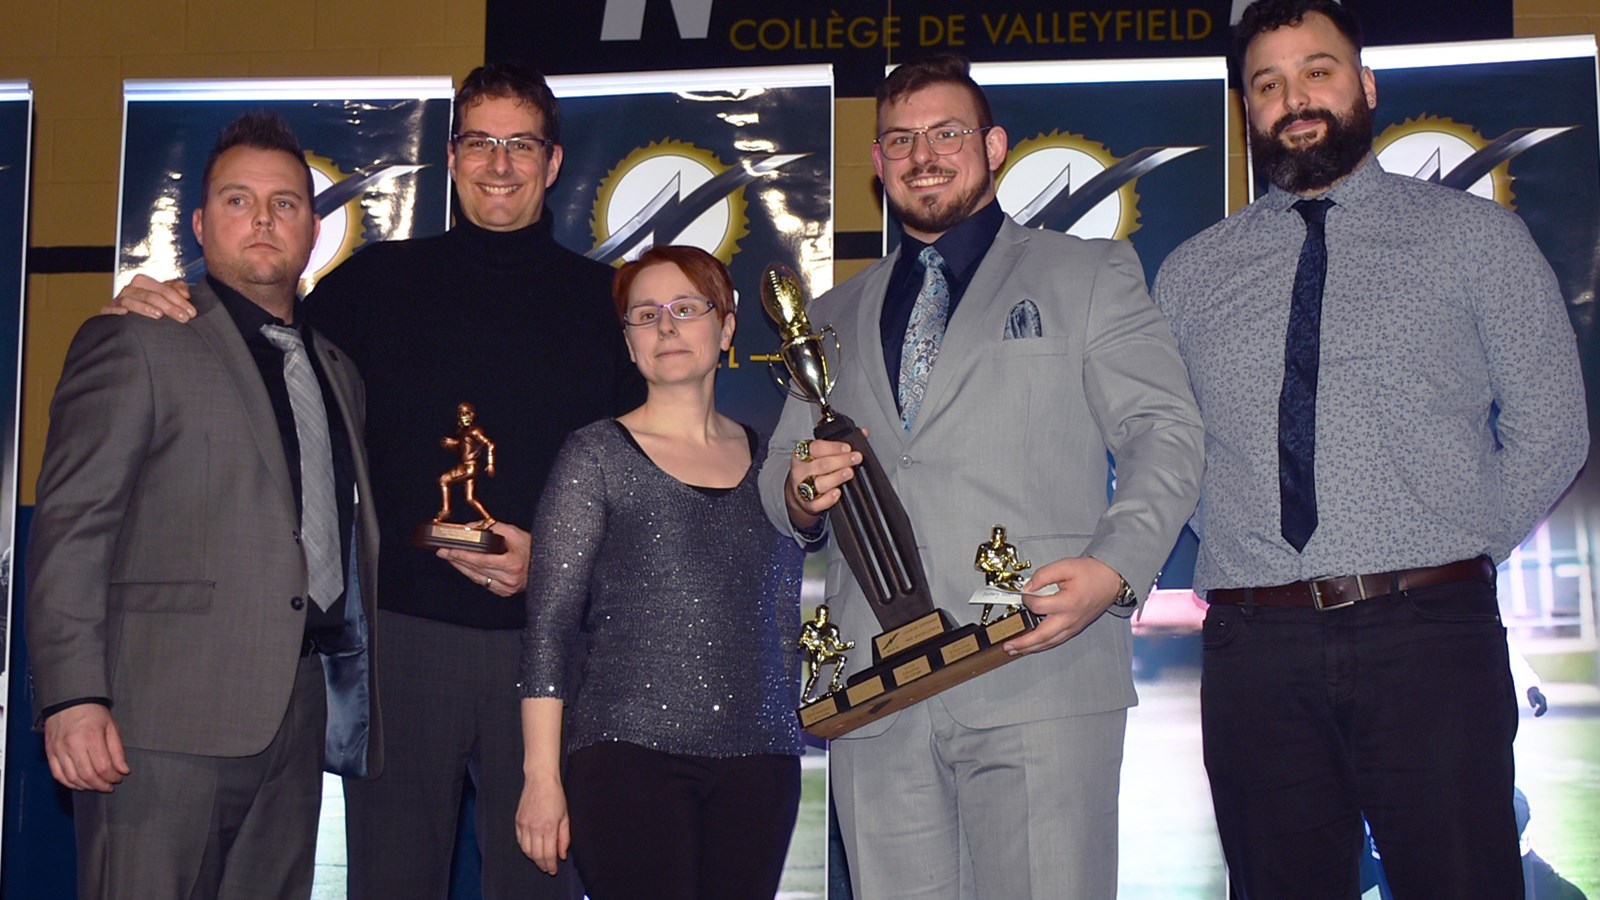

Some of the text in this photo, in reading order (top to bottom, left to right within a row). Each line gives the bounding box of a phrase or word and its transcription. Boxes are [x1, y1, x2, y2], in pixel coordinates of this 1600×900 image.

[729, 10, 900, 51] COLLÈGE
[919, 15, 965, 47] DE
[982, 9, 1213, 45] VALLEYFIELD
